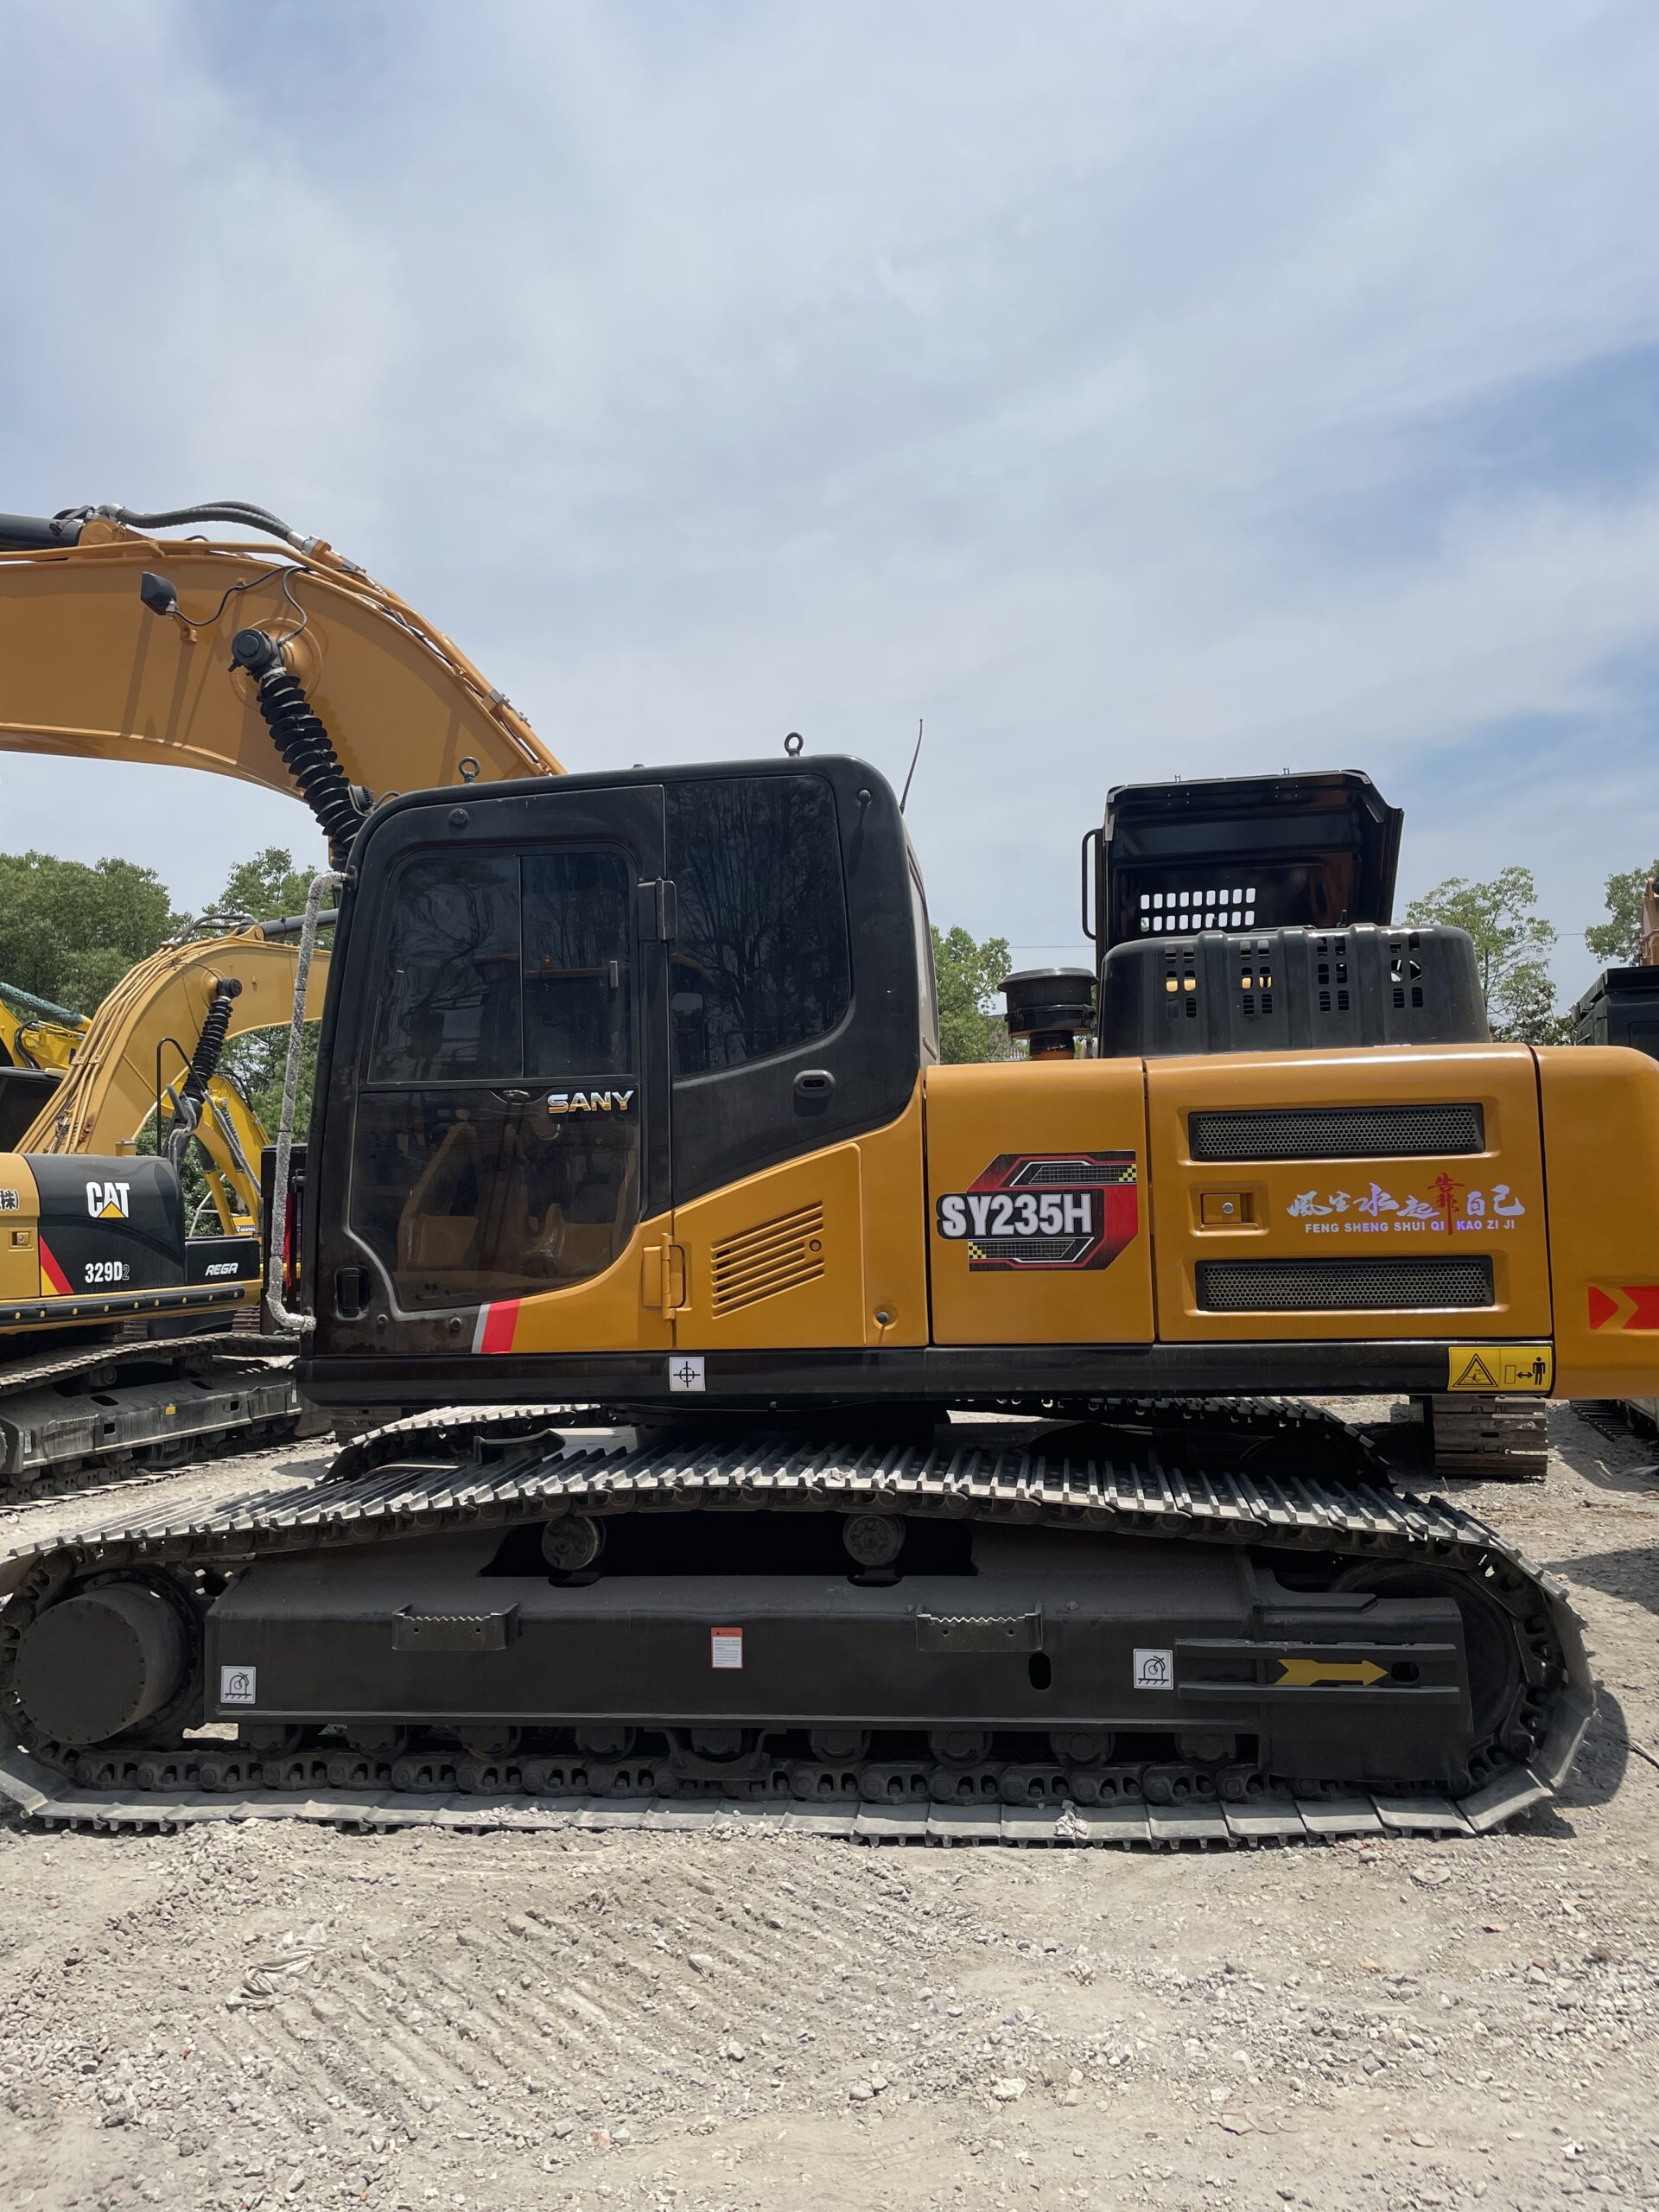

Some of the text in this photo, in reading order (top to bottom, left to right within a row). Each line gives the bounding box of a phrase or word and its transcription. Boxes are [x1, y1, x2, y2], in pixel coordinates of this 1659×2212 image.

[547, 1090, 634, 1114] SANY
[86, 1181, 130, 1218] CAT
[940, 1193, 1092, 1237] SY235H
[1305, 1219, 1515, 1233] FENG SHENG SHUI QI KAO ZI JI
